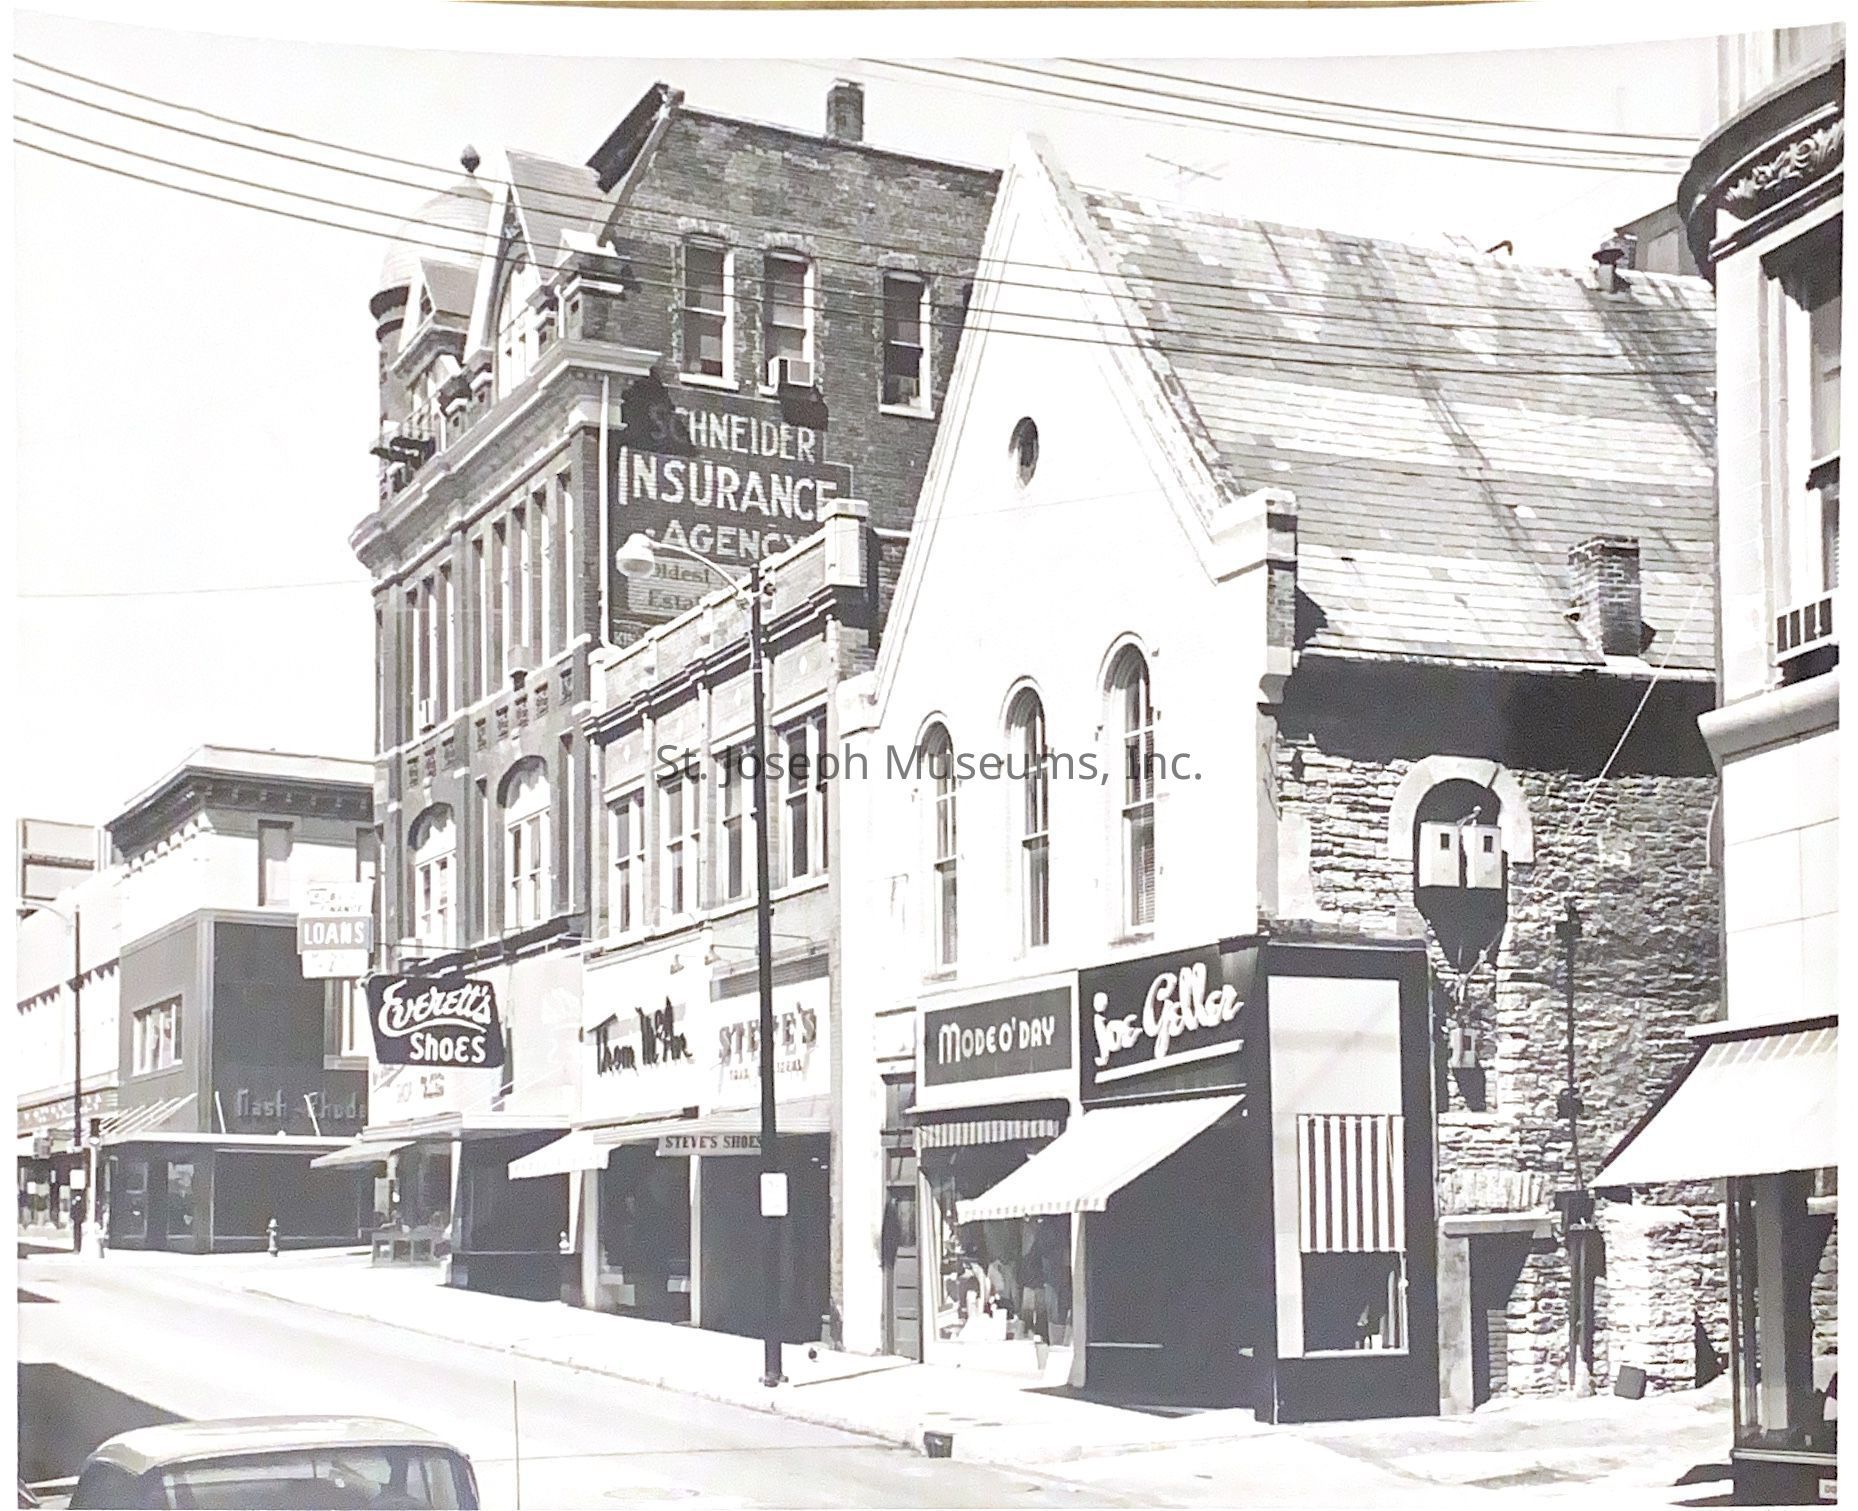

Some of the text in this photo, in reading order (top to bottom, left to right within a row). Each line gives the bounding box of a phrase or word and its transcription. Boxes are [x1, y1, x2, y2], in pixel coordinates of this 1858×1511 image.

[648, 404, 816, 464] SCHNEIDER
[617, 445, 838, 522] INSURANCE
[303, 921, 365, 945] LOANS
[718, 1001, 818, 1060] STEE'S
[665, 1135, 718, 1149] STEVE'S
